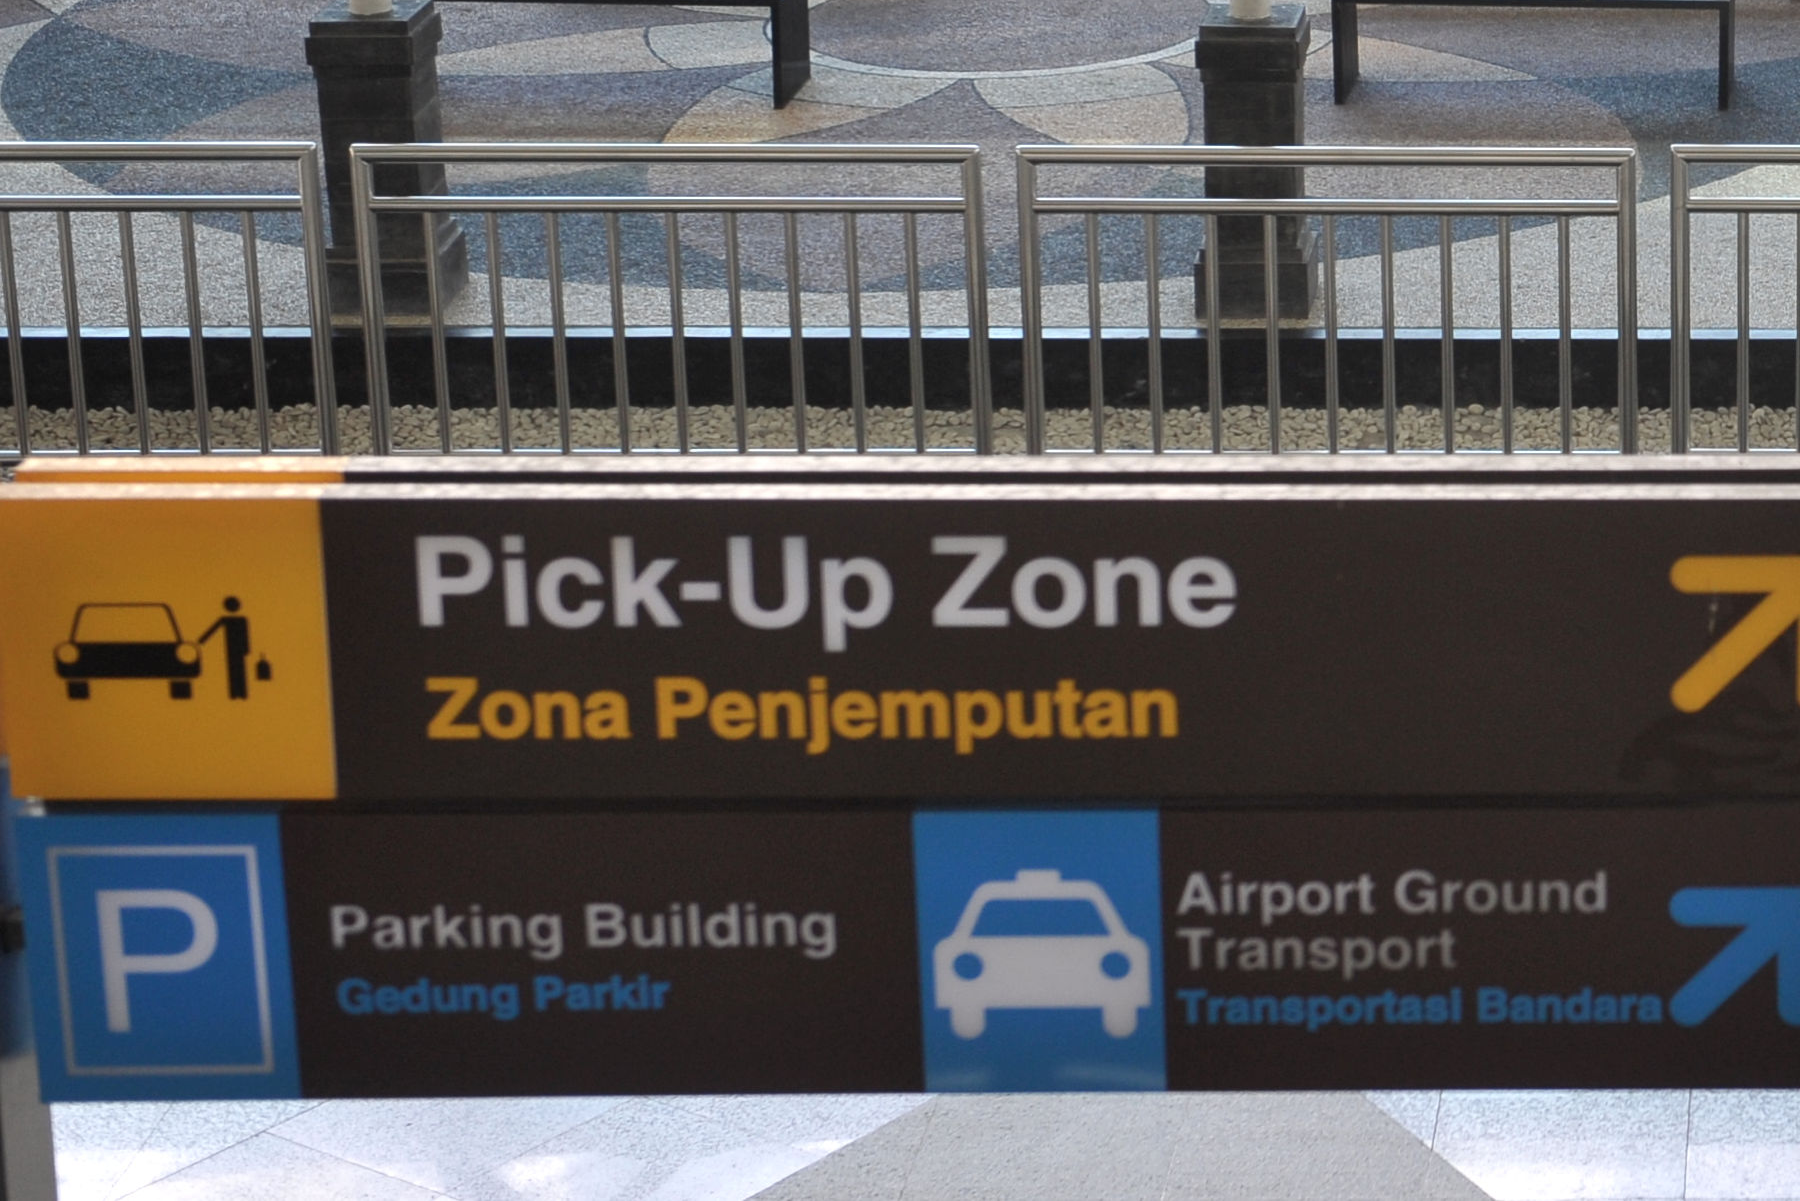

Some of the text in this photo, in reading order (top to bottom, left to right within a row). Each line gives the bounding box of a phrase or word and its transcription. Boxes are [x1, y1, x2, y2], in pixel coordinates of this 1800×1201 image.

[417, 536, 1236, 651] Pick-Up Zone
[426, 676, 1178, 755] Zona Penjemputan
[1178, 870, 1607, 923] Airport Ground
[331, 903, 836, 960] Parking Building
[1177, 928, 1455, 979] Transport
[97, 889, 218, 1030] P
[337, 974, 670, 1021] Gedung Parkir
[1177, 987, 1664, 1031] Transportasi Bandara
